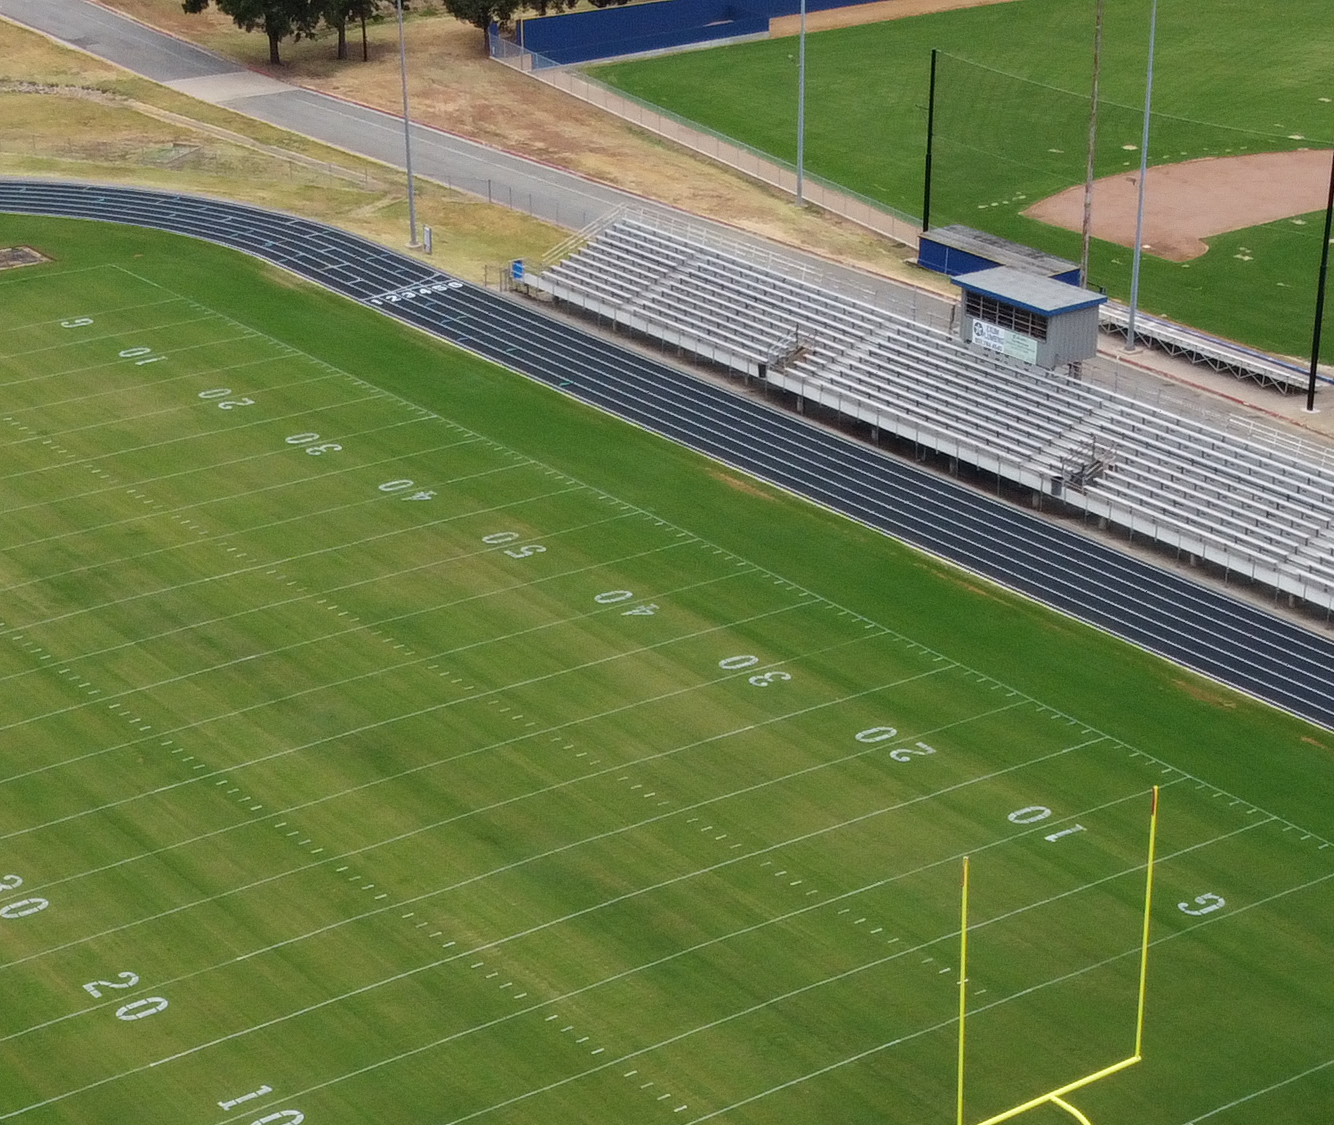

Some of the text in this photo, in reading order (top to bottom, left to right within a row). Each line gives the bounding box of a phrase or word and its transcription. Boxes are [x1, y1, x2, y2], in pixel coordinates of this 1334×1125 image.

[119, 347, 168, 366] 10
[198, 388, 255, 410] 20
[285, 432, 343, 456] 30
[378, 479, 438, 501] 40
[482, 531, 546, 559] 50
[594, 590, 660, 616] 40
[719, 655, 791, 687] 30
[855, 726, 936, 762] 20
[1007, 806, 1087, 842] 10
[1178, 892, 1225, 916] G
[82, 971, 168, 1021] 20
